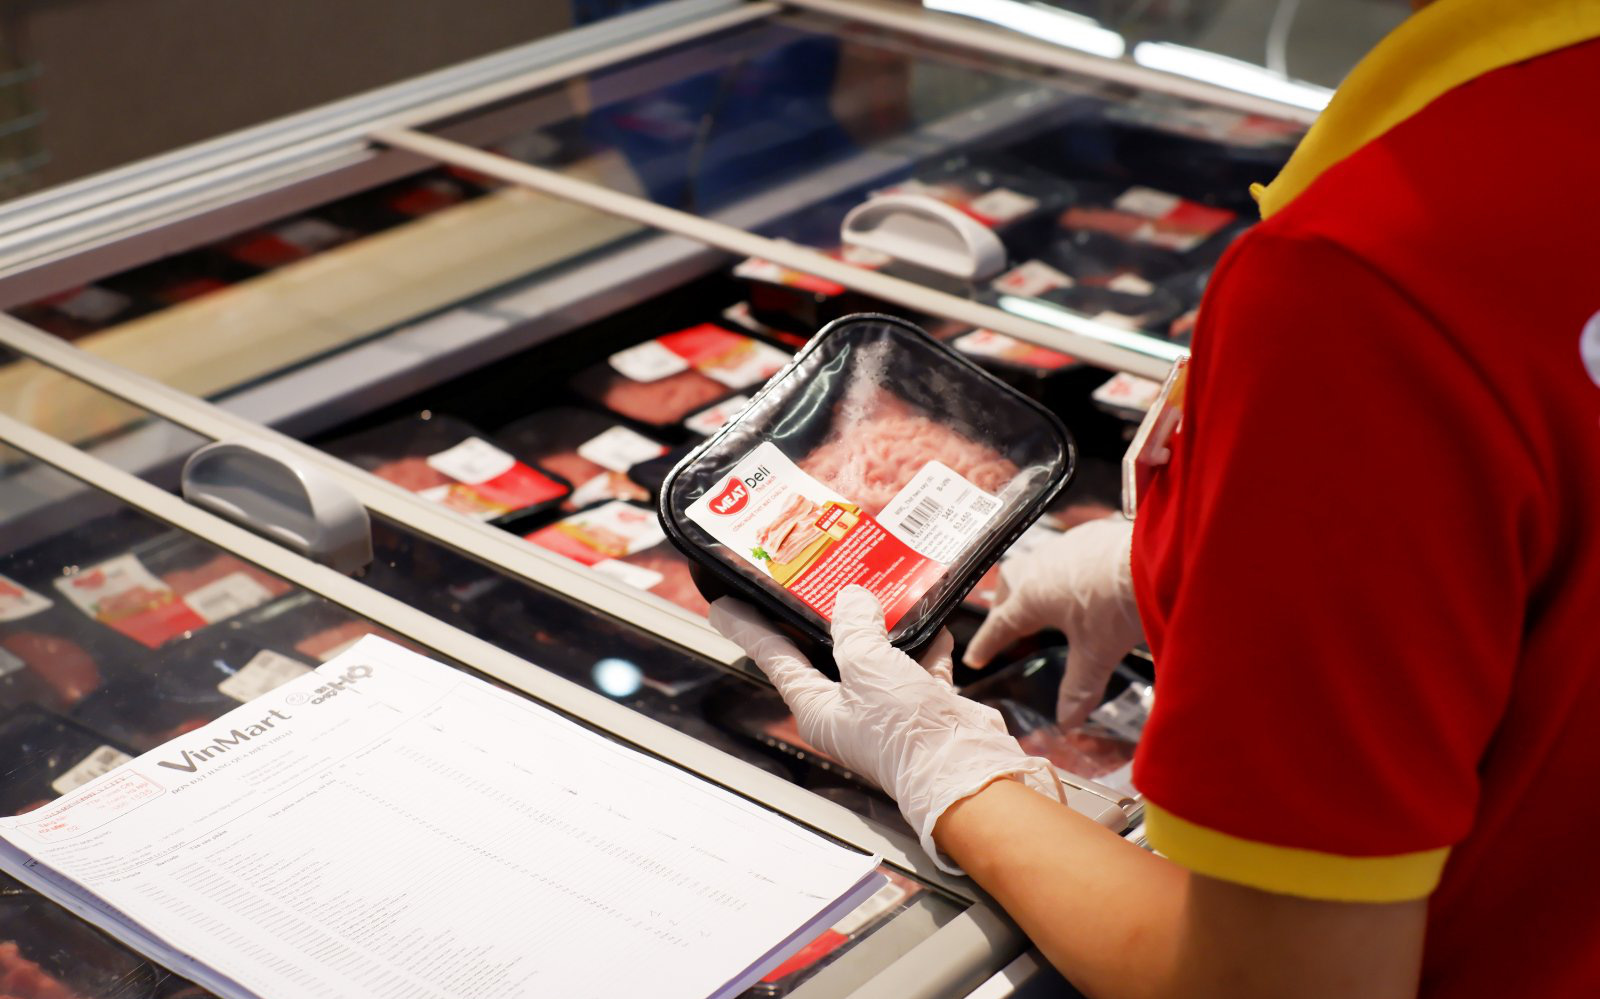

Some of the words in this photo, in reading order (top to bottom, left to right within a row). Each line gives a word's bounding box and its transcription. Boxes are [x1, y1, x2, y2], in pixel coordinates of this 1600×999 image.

[715, 486, 747, 513] MEAT
[744, 464, 771, 489] Deli
[156, 709, 293, 773] VinMart
